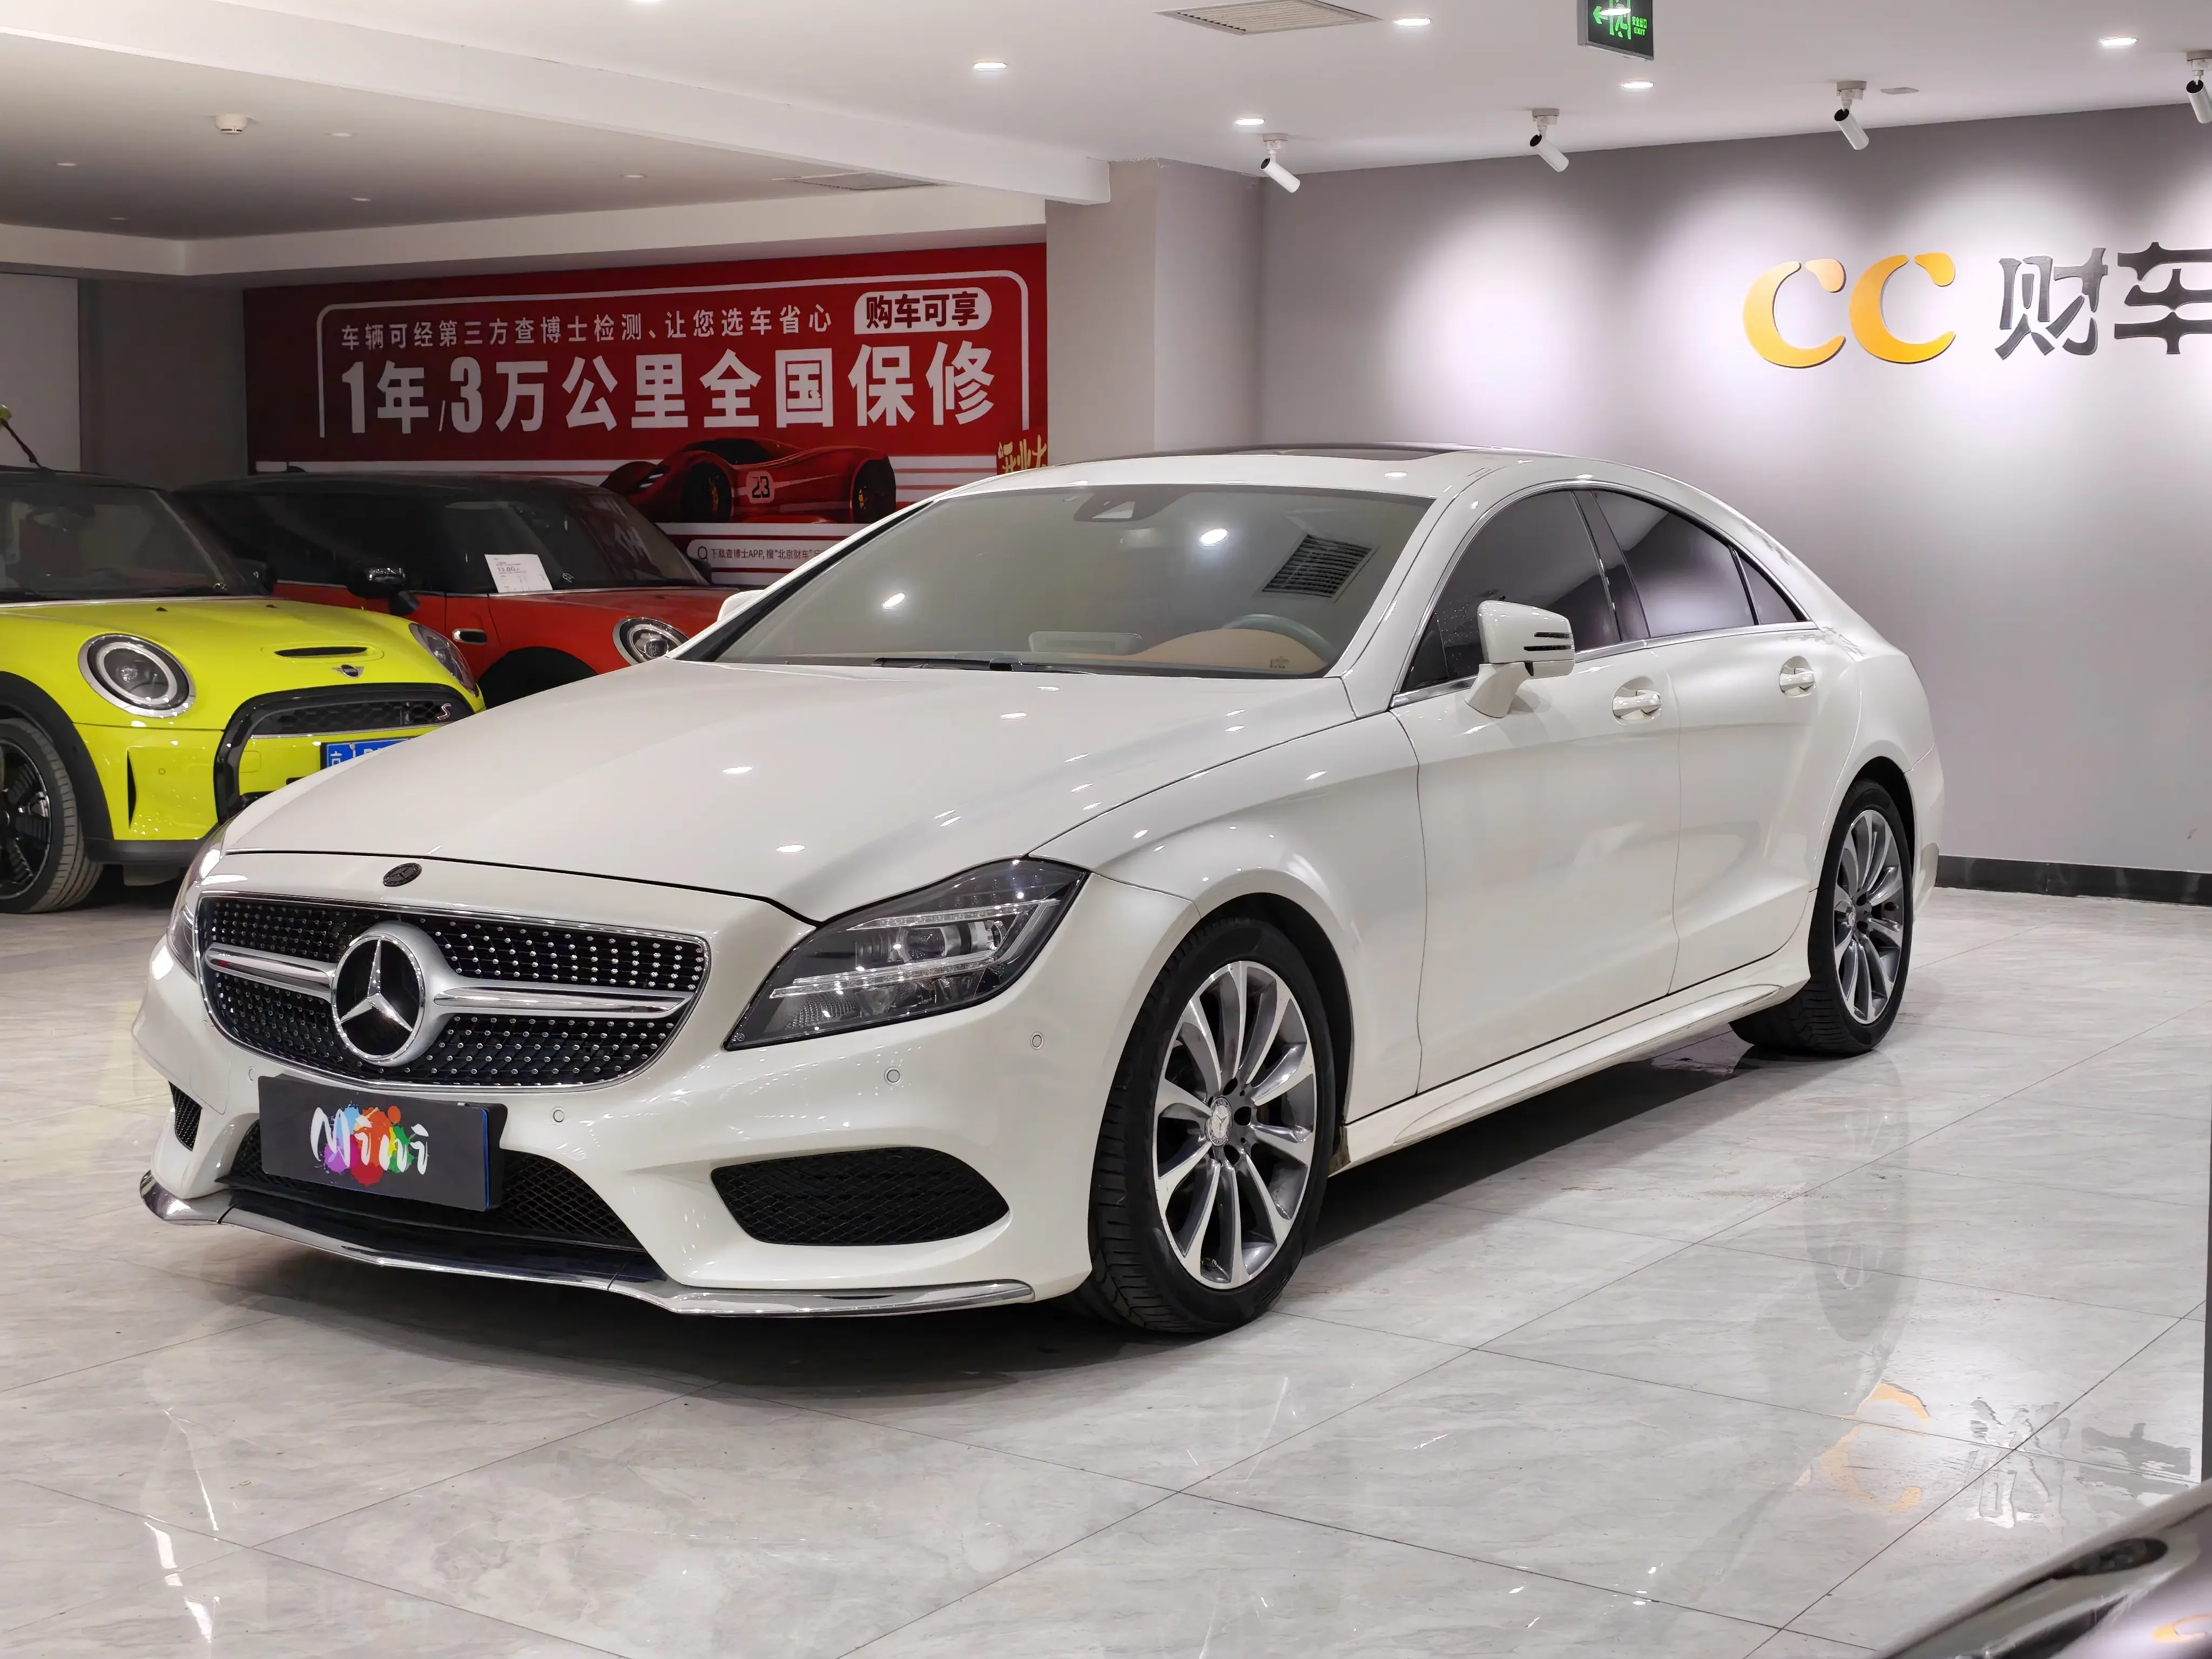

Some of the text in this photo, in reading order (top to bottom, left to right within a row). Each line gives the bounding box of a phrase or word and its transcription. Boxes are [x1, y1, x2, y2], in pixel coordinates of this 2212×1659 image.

[1634, 27, 1645, 36] EXIT
[866, 291, 979, 329] 购车可享
[1995, 242, 2212, 360] 财车
[751, 476, 770, 498] 23
